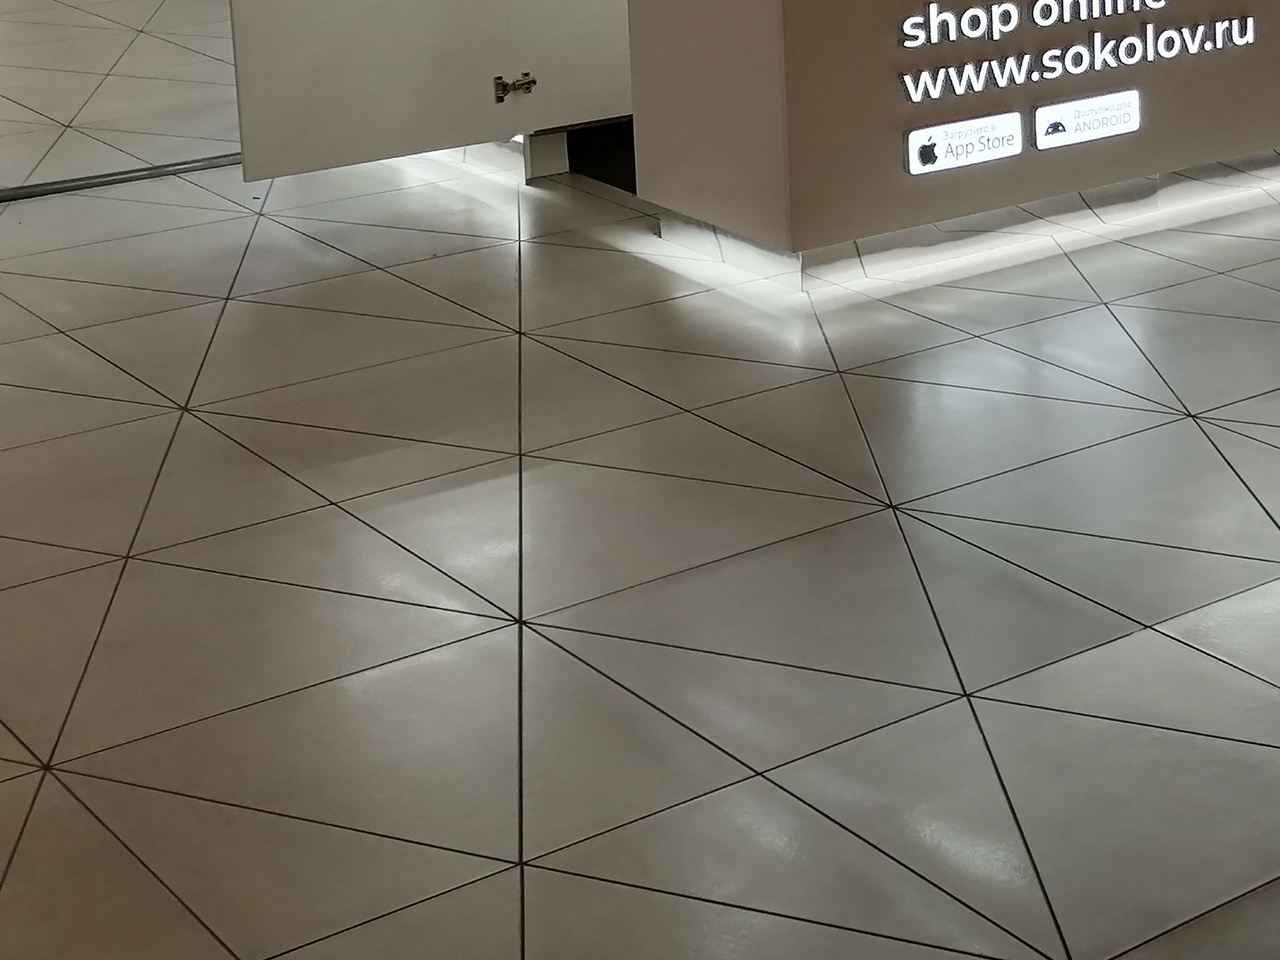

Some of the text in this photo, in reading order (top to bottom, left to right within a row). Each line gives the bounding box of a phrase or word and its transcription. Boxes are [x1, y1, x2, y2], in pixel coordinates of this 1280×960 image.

[902, 1, 1018, 49] shop
[903, 15, 1256, 103] www.sokolov.ru
[1073, 112, 1132, 134] ANDROID
[943, 133, 1015, 161] App Store
